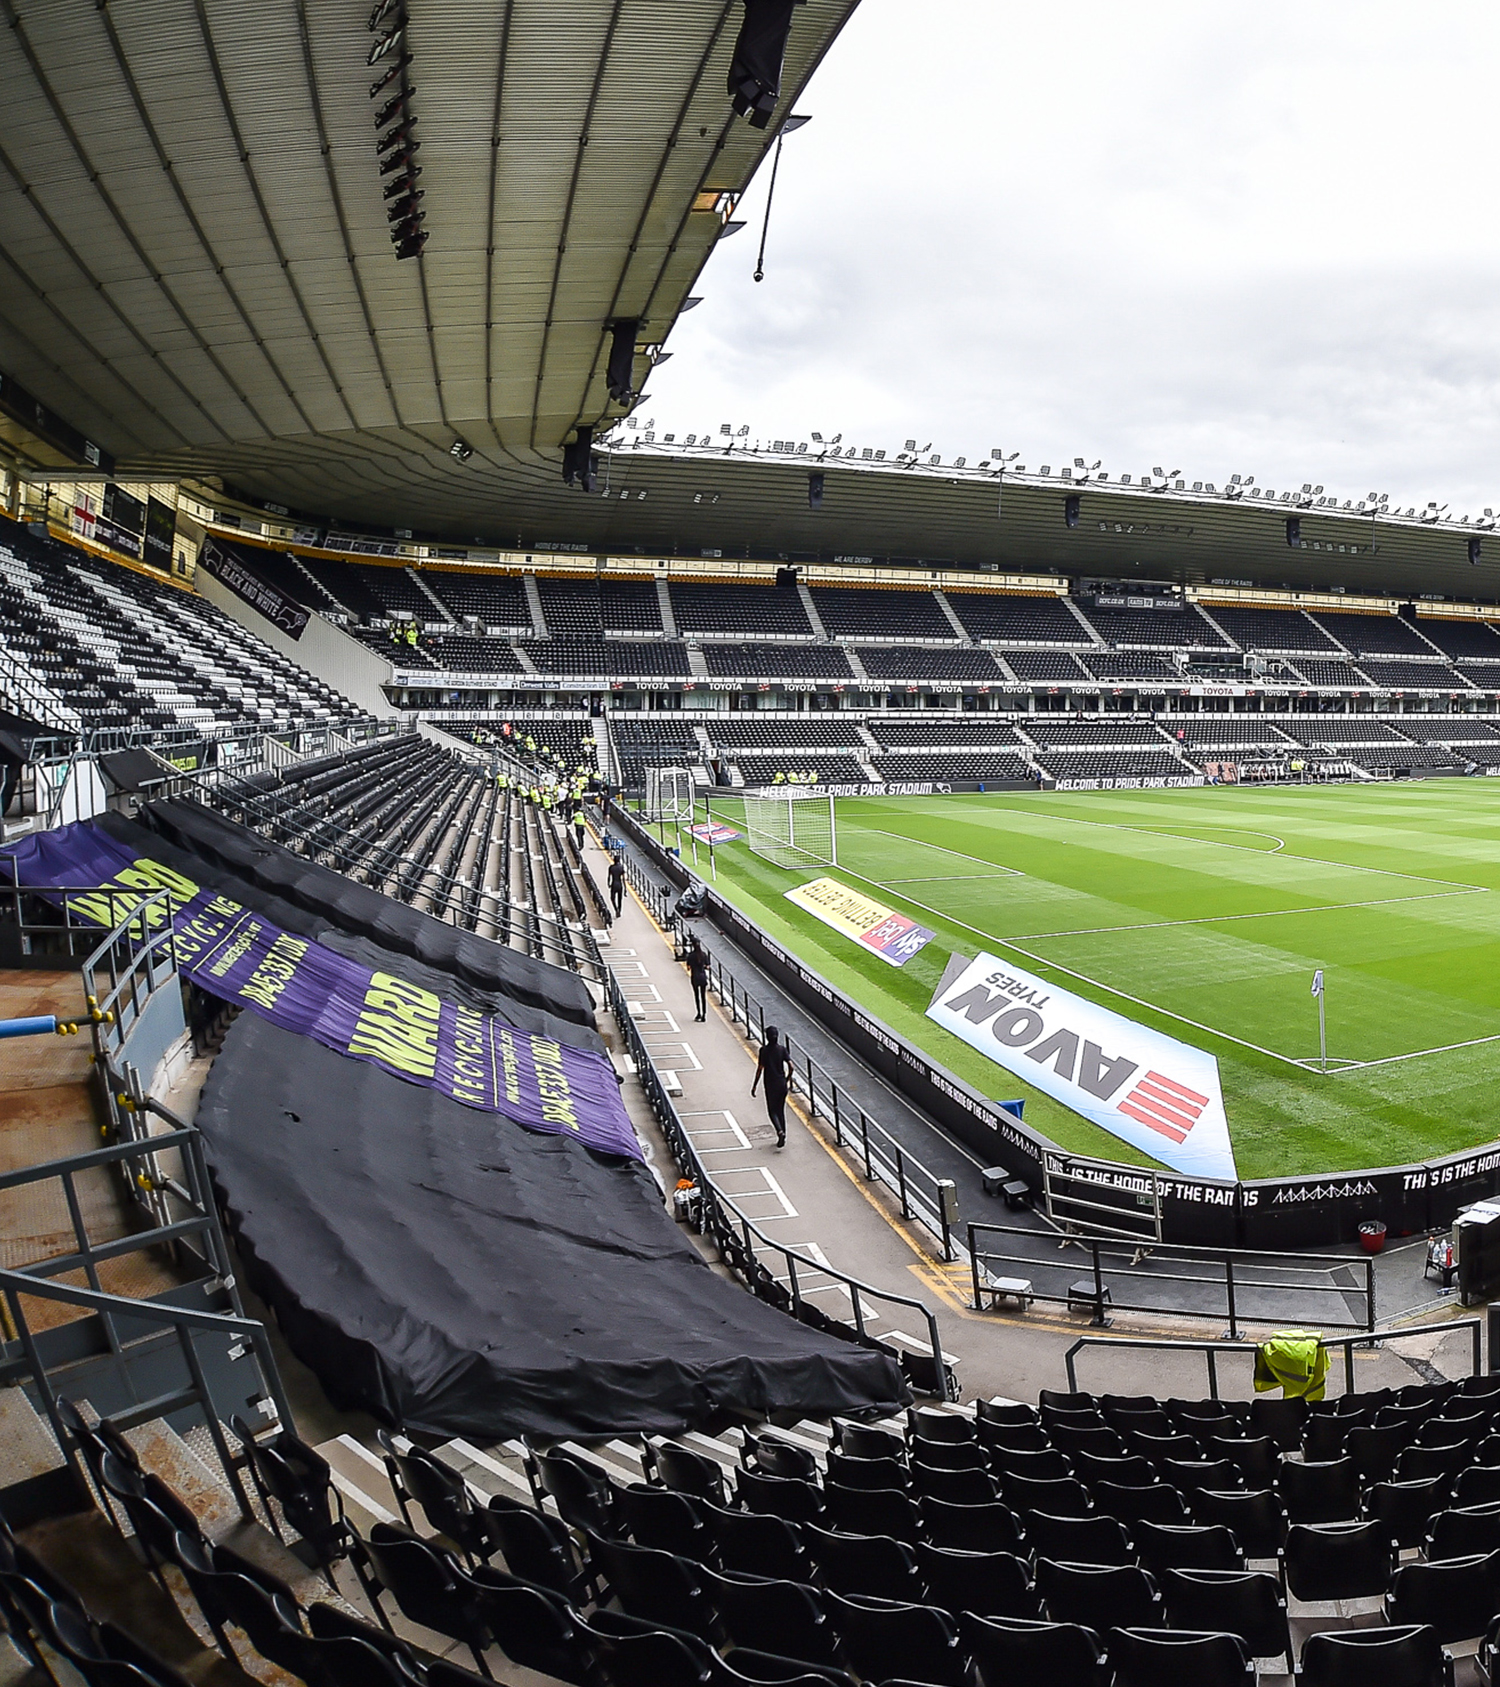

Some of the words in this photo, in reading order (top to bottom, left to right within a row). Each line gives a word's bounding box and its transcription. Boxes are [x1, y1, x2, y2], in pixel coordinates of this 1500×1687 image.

[220, 564, 245, 589] BLACK
[241, 582, 258, 600] AND
[255, 592, 280, 616] WHITE
[635, 682, 669, 690] TOYOTA
[708, 683, 743, 691] TOYOTA
[783, 684, 817, 692] TOYOTA
[857, 685, 891, 693] TOYOTA
[931, 685, 963, 694] TOYOTA
[1002, 686, 1033, 694] TOYOTA
[1071, 687, 1100, 695] TOYOTA
[1138, 688, 1166, 696] TOYOTA
[1202, 687, 1234, 695] TOYOTA
[1264, 689, 1290, 697] TOYOTA
[1317, 690, 1341, 698] TOYOTA
[828, 784, 860, 796] PRIDE
[860, 783, 887, 796] PARK
[888, 782, 933, 795] STADIUM
[1055, 777, 1100, 791] WELCOME
[1101, 778, 1114, 789] TO
[1114, 777, 1142, 789] PRIDE
[1142, 776, 1166, 788] PARK
[1167, 776, 1204, 787] STADIUM
[60, 858, 200, 940] WARD
[802, 882, 843, 906] BETTER
[831, 897, 883, 929] BETTING
[869, 919, 905, 947] bet
[892, 927, 927, 957] sky
[985, 972, 1050, 1010] TYRES
[348, 971, 441, 1077] WARD
[944, 984, 1139, 1101] AVON
[453, 1005, 485, 1104] RECYCLING
[1048, 1156, 1064, 1174] THIS
[1085, 1169, 1111, 1185] THE
[1113, 1175, 1154, 1195] HOME
[1156, 1182, 1174, 1198] OF
[1176, 1184, 1202, 1202] THE
[1440, 1167, 1454, 1184] IS
[1455, 1160, 1477, 1180] THE
